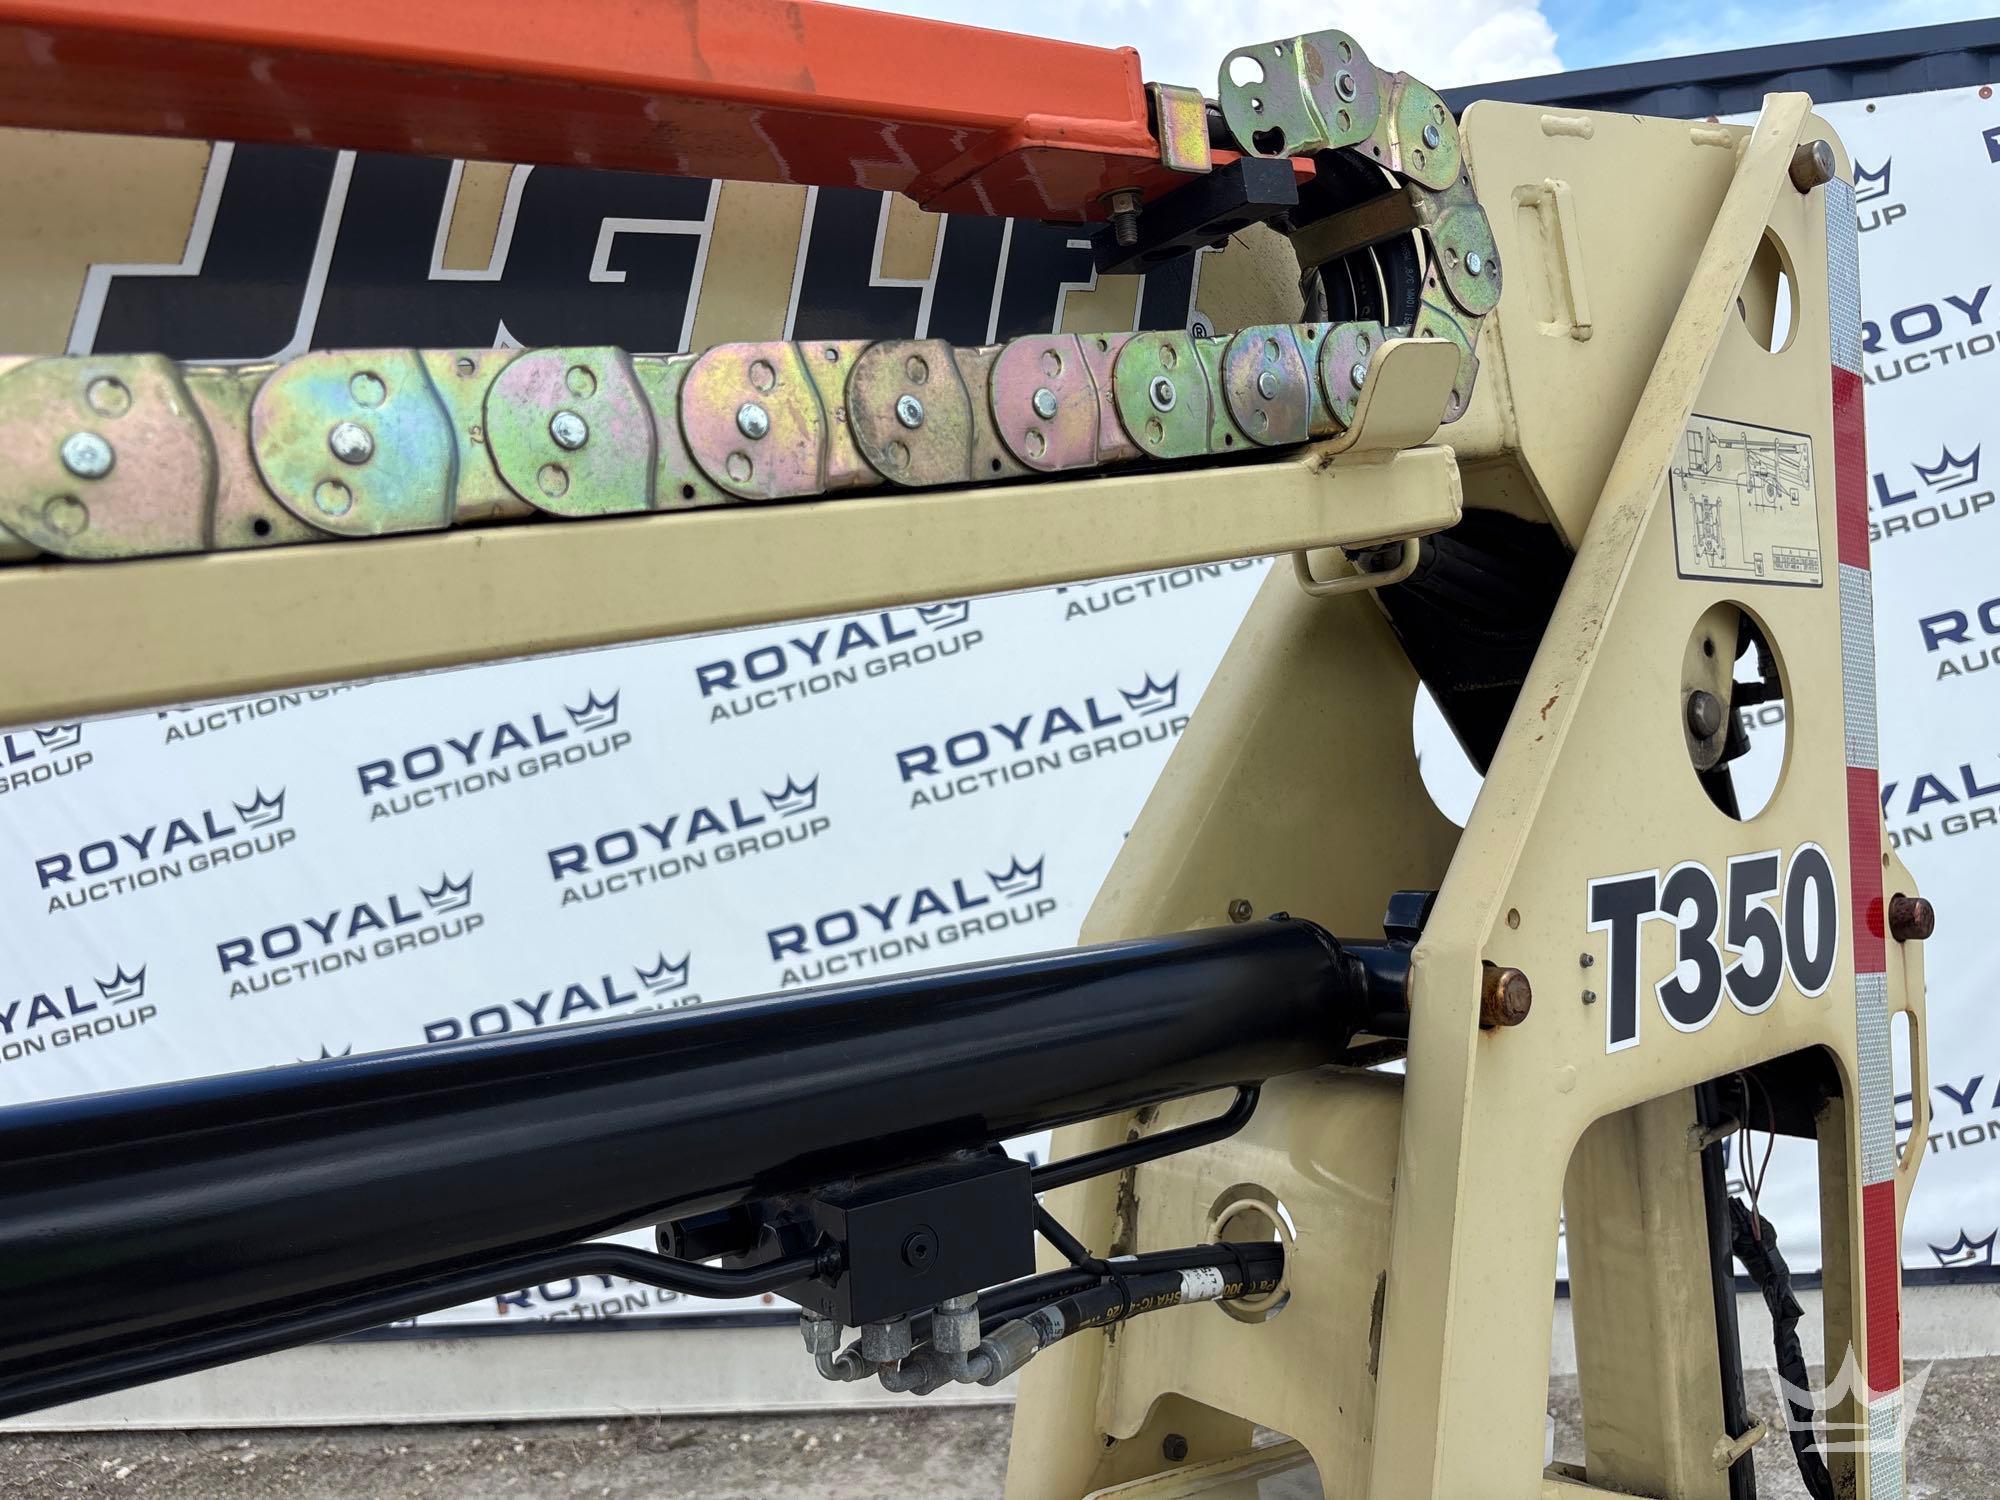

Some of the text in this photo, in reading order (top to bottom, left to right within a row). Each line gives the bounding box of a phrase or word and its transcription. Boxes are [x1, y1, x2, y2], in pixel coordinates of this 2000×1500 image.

[1065, 566, 1221, 621] AUCTION
[696, 613, 917, 698] ROYAL
[711, 631, 982, 723] AUCTION GROUP
[165, 696, 302, 744] AUCTION
[357, 714, 567, 796] ROYAL
[896, 698, 1122, 783] ROYAL
[912, 716, 1190, 808] AUCTION GROUP
[371, 732, 631, 820] AUCTION GROUP
[35, 811, 236, 889] ROYAL
[49, 829, 295, 914] AUCTION GROUP
[547, 798, 765, 881] ROYAL
[562, 817, 830, 906] AUCTION GROUP
[217, 895, 422, 974] ROYAL
[230, 914, 483, 998] AUCTION GROUP
[767, 879, 989, 961] ROYAL
[781, 899, 1056, 988] AUCTION GROUP
[1588, 842, 1838, 1053] T350
[0, 985, 98, 1034] YAL
[51, 1005, 156, 1047] GROUP
